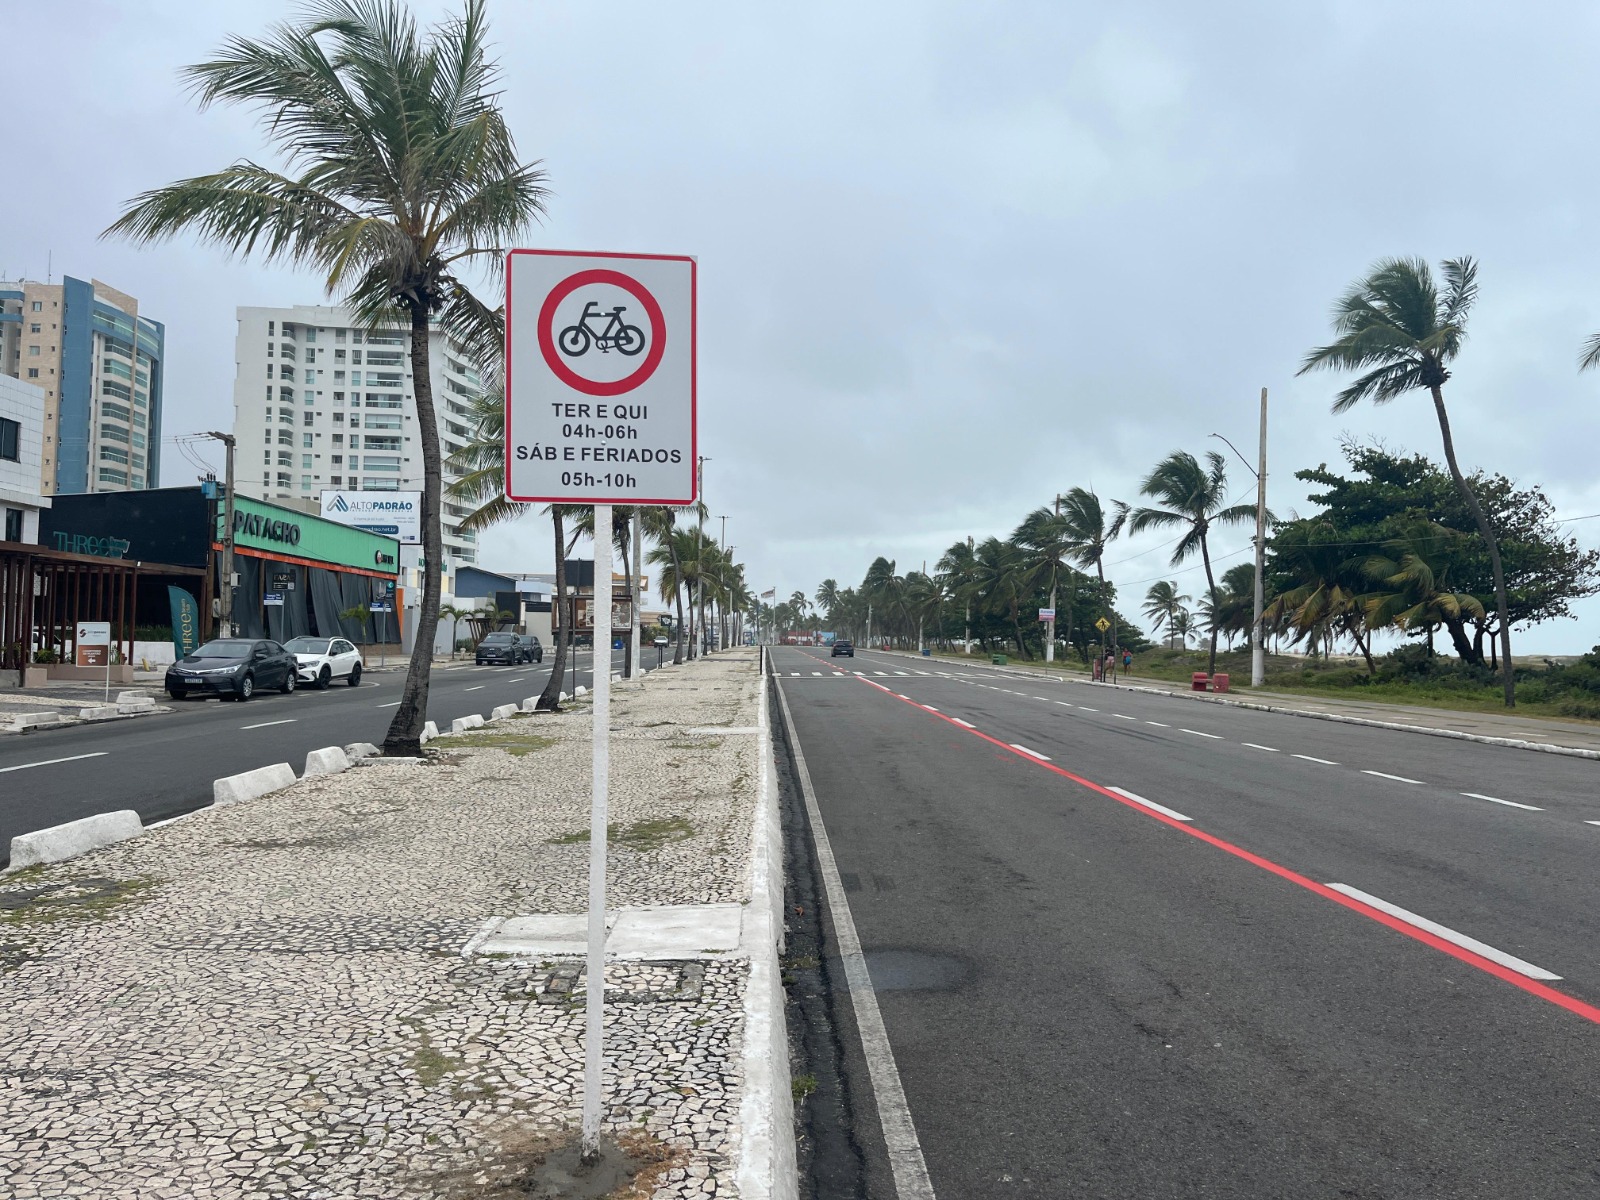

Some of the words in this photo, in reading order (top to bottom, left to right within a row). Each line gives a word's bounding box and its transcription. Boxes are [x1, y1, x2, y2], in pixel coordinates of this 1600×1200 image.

[552, 403, 591, 418] TER
[596, 404, 608, 418] E
[613, 405, 648, 419] QUI
[562, 424, 638, 439] 04h-06h
[516, 442, 557, 460] SÁB
[563, 447, 575, 461] E
[581, 448, 682, 464] FERIADOS
[561, 472, 637, 488] 05h-10h
[234, 509, 301, 545] PATACHO
